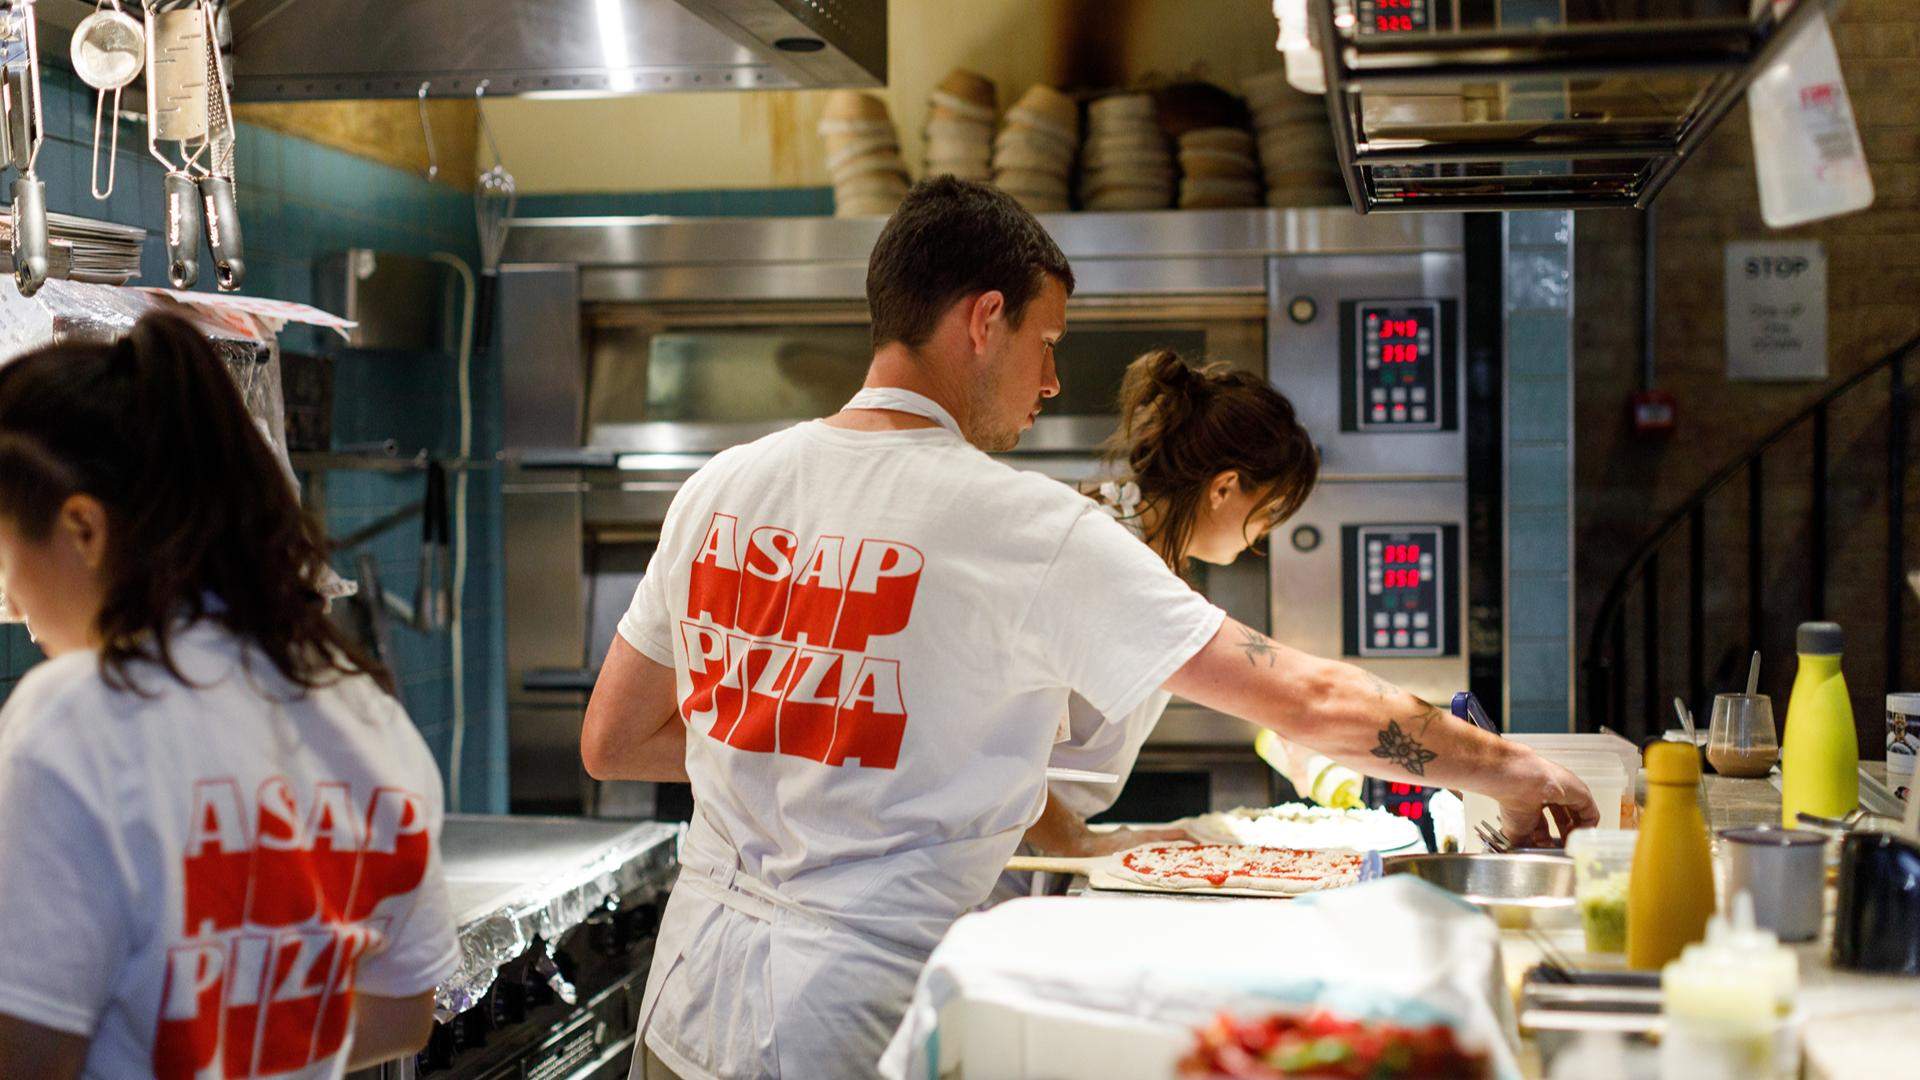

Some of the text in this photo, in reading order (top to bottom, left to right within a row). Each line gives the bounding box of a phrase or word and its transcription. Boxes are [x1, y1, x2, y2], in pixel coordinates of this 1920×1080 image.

[1744, 256, 1809, 279] STOP
[687, 512, 924, 653] ASAP
[680, 621, 908, 770] PIZZA
[182, 774, 430, 937] ASAP
